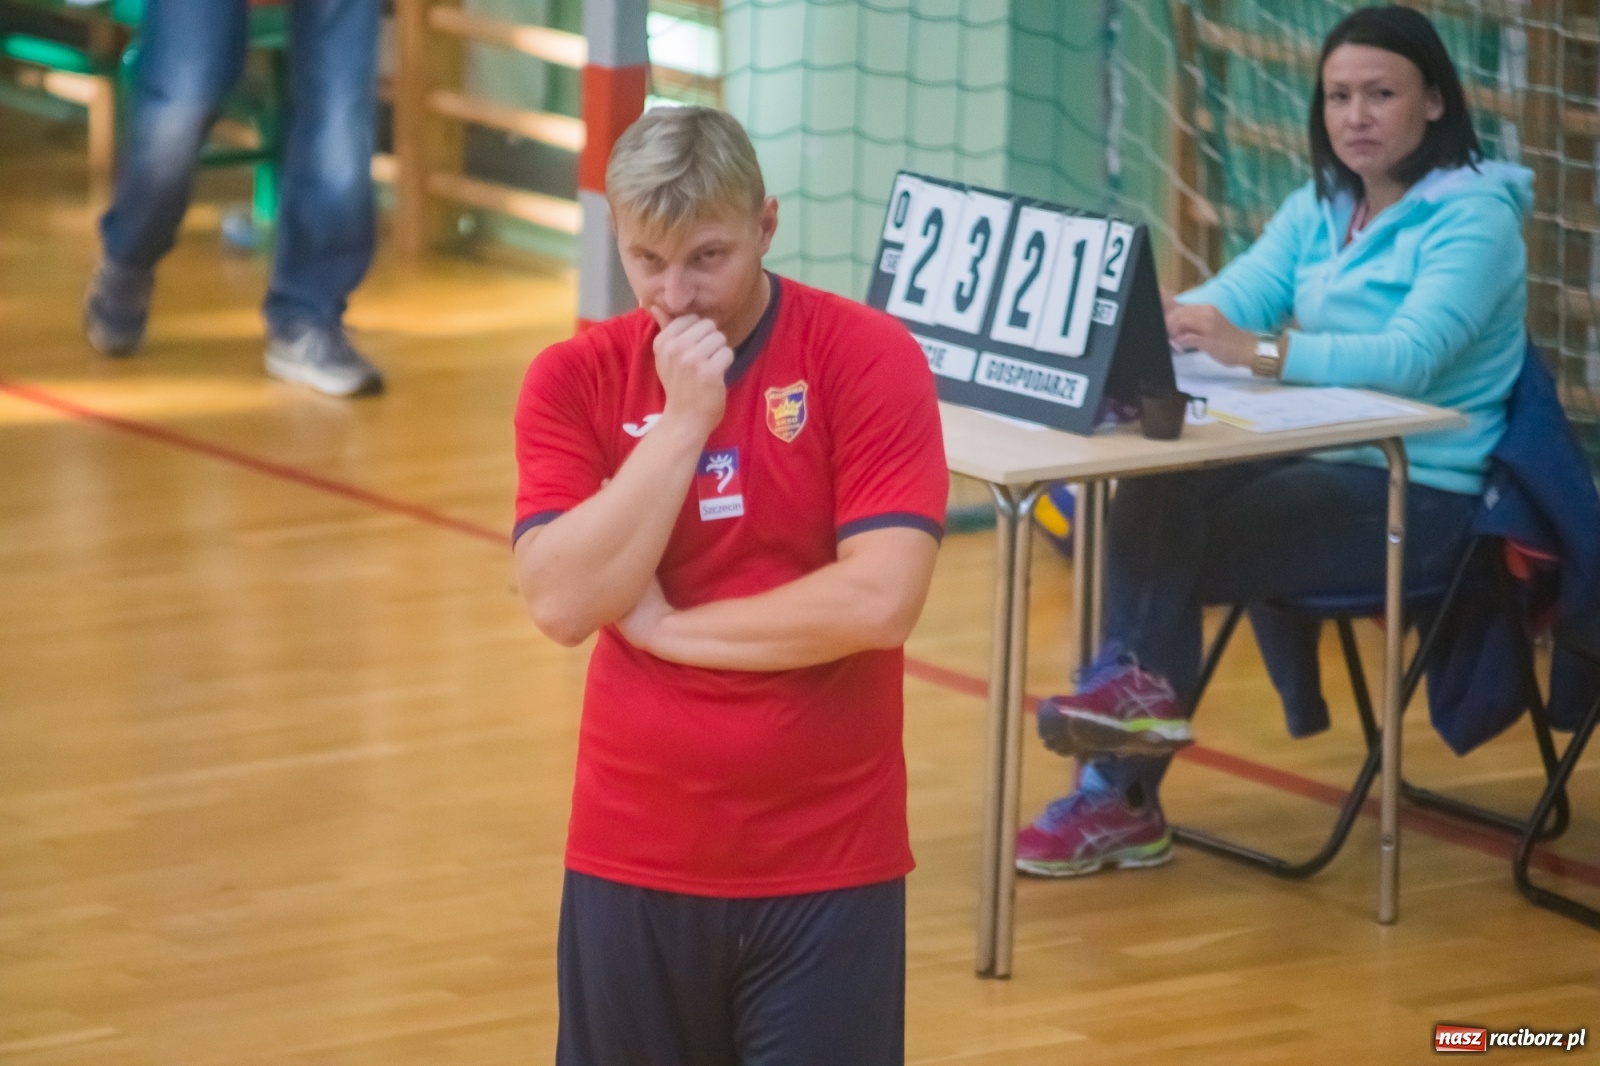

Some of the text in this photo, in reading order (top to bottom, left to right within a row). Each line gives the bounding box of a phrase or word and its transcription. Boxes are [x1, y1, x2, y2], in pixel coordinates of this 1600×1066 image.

[893, 190, 910, 229] 0
[1105, 236, 1124, 277] 2
[985, 359, 1078, 401] GOSPODARZE
[702, 502, 742, 516] Szczecin
